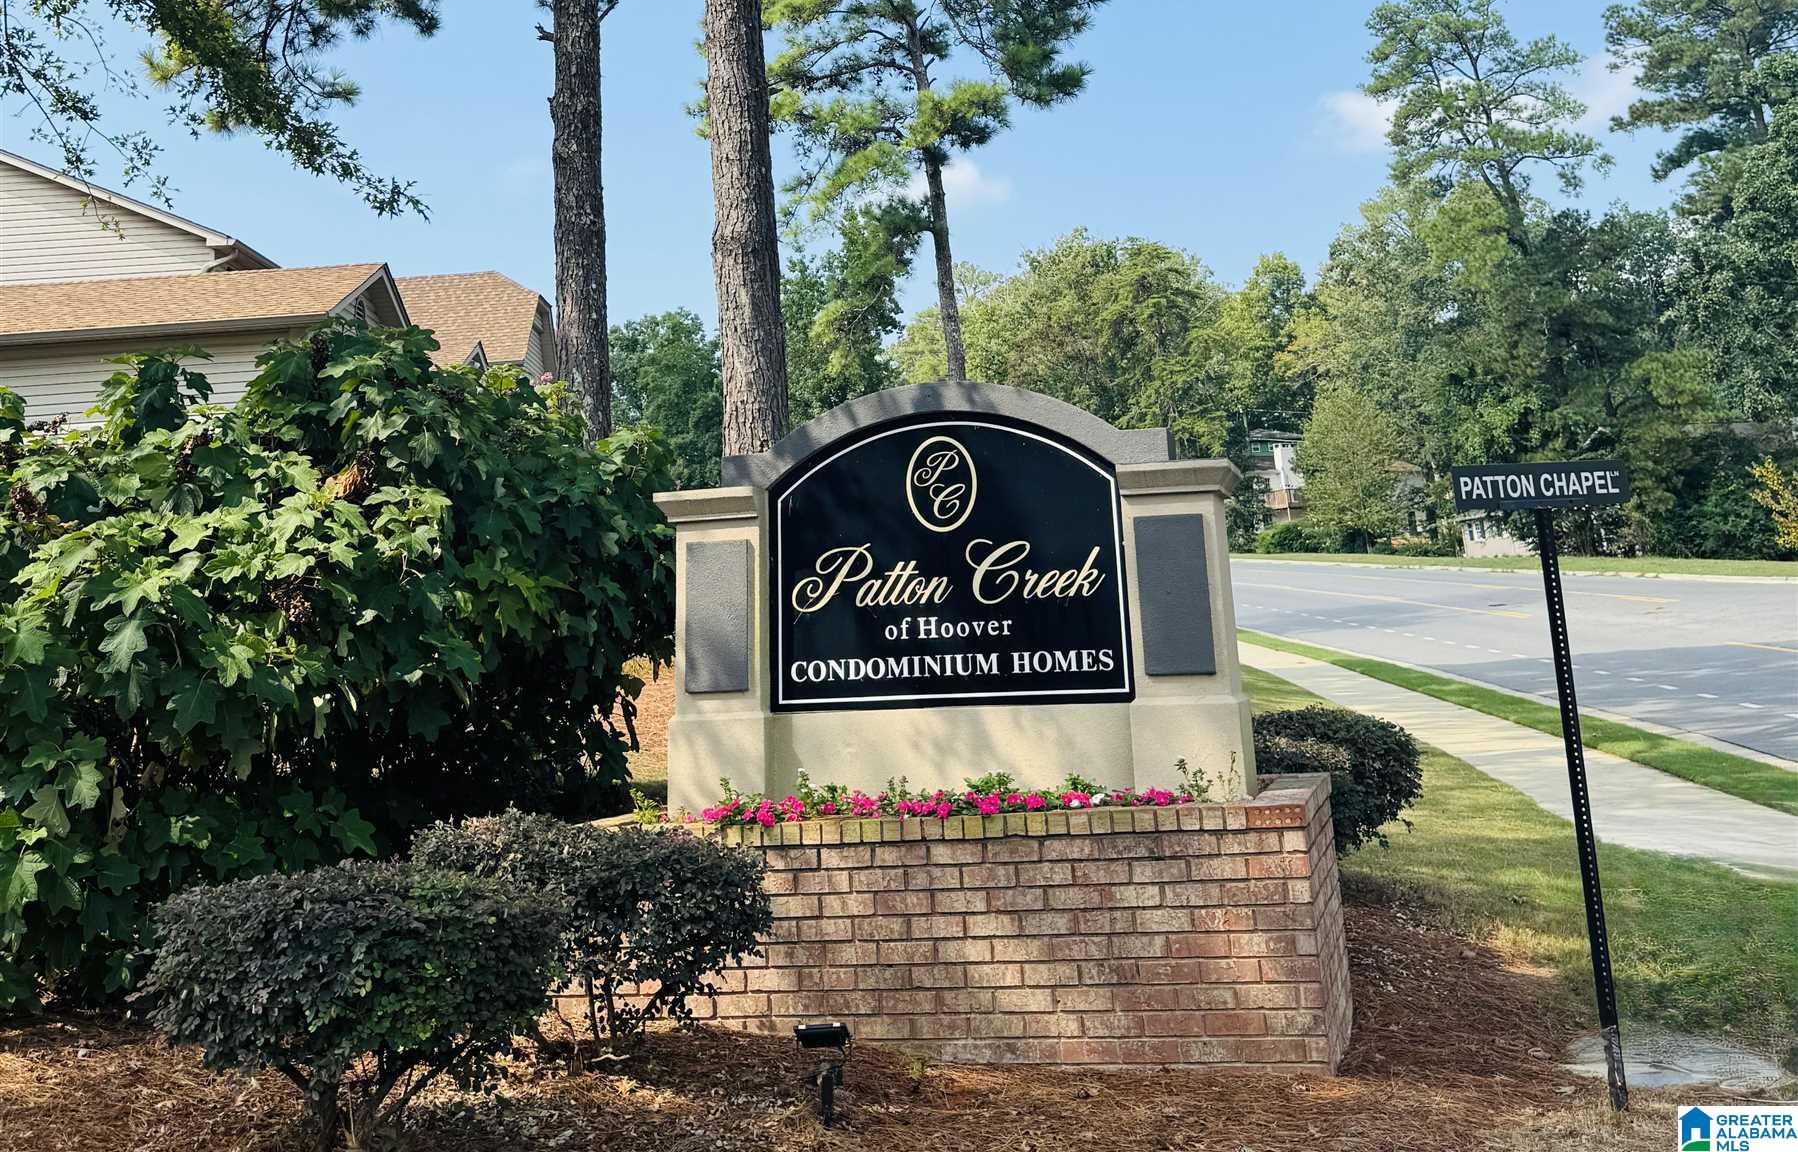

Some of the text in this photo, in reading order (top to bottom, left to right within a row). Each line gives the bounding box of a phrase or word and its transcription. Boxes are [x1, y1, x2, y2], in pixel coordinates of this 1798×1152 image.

[913, 450, 960, 488] P
[1459, 474, 1536, 500] PATTON
[1540, 471, 1620, 497] CHAPEL
[929, 483, 966, 519] C
[791, 538, 1106, 613] Patton Creek
[884, 617, 1014, 641] of Hoover
[790, 648, 1115, 682] CONDOMINIUM HOMES
